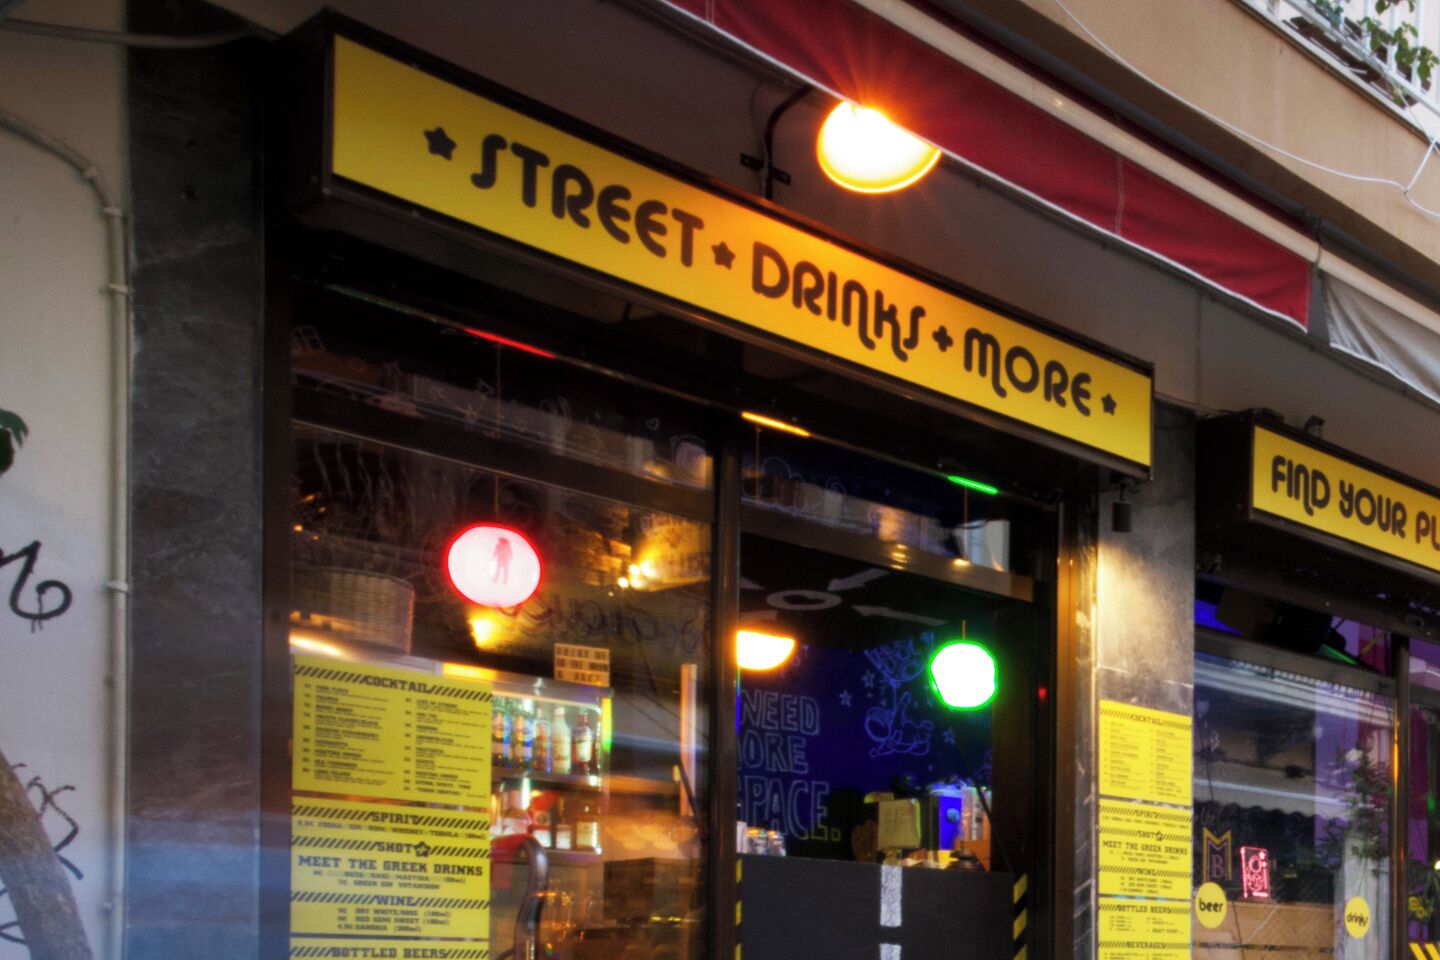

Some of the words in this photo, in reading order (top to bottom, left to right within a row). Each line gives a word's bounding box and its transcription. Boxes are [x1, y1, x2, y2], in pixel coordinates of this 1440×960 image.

[470, 134, 704, 268] STREET
[752, 241, 926, 362] DRINKS
[964, 327, 1092, 417] MORE
[1271, 455, 1331, 517] FIND
[1339, 479, 1407, 539] YOUR
[364, 675, 430, 694] COCKTAIL
[741, 689, 820, 736] NEED
[737, 730, 809, 775] ORE
[372, 810, 418, 825] SPIRIT
[377, 841, 413, 854] SHOT
[298, 854, 342, 868] MEET
[348, 858, 377, 871] THE
[383, 860, 428, 874] GREEK
[434, 863, 484, 877] DRINKS
[376, 894, 417, 907] WINE
[1198, 897, 1224, 913] beer
[332, 946, 397, 958] BOTTLED
[404, 947, 448, 959] BEERS
